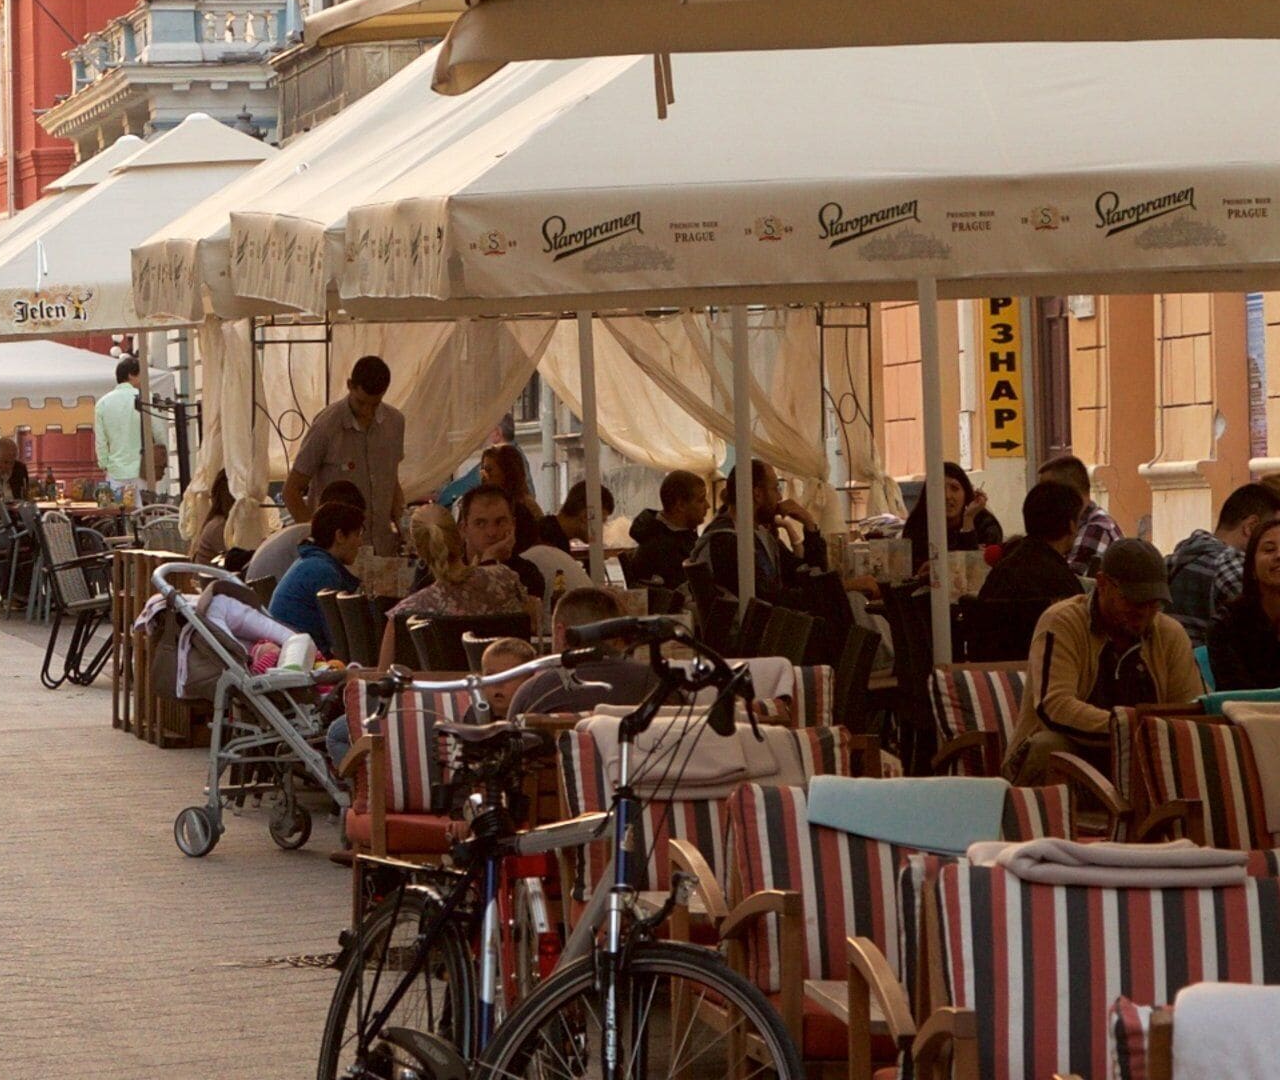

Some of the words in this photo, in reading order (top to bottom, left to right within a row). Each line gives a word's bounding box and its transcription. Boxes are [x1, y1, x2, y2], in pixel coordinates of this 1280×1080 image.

[818, 199, 921, 240] Staropramen
[1095, 187, 1196, 229] Staropramen
[1227, 207, 1268, 219] PRAGUE
[542, 210, 644, 254] Staropramen
[675, 231, 715, 243] PRAGUE
[951, 221, 992, 233] PRAGUE
[13, 300, 67, 323] Jelen
[989, 297, 1019, 429] РЗНАР
